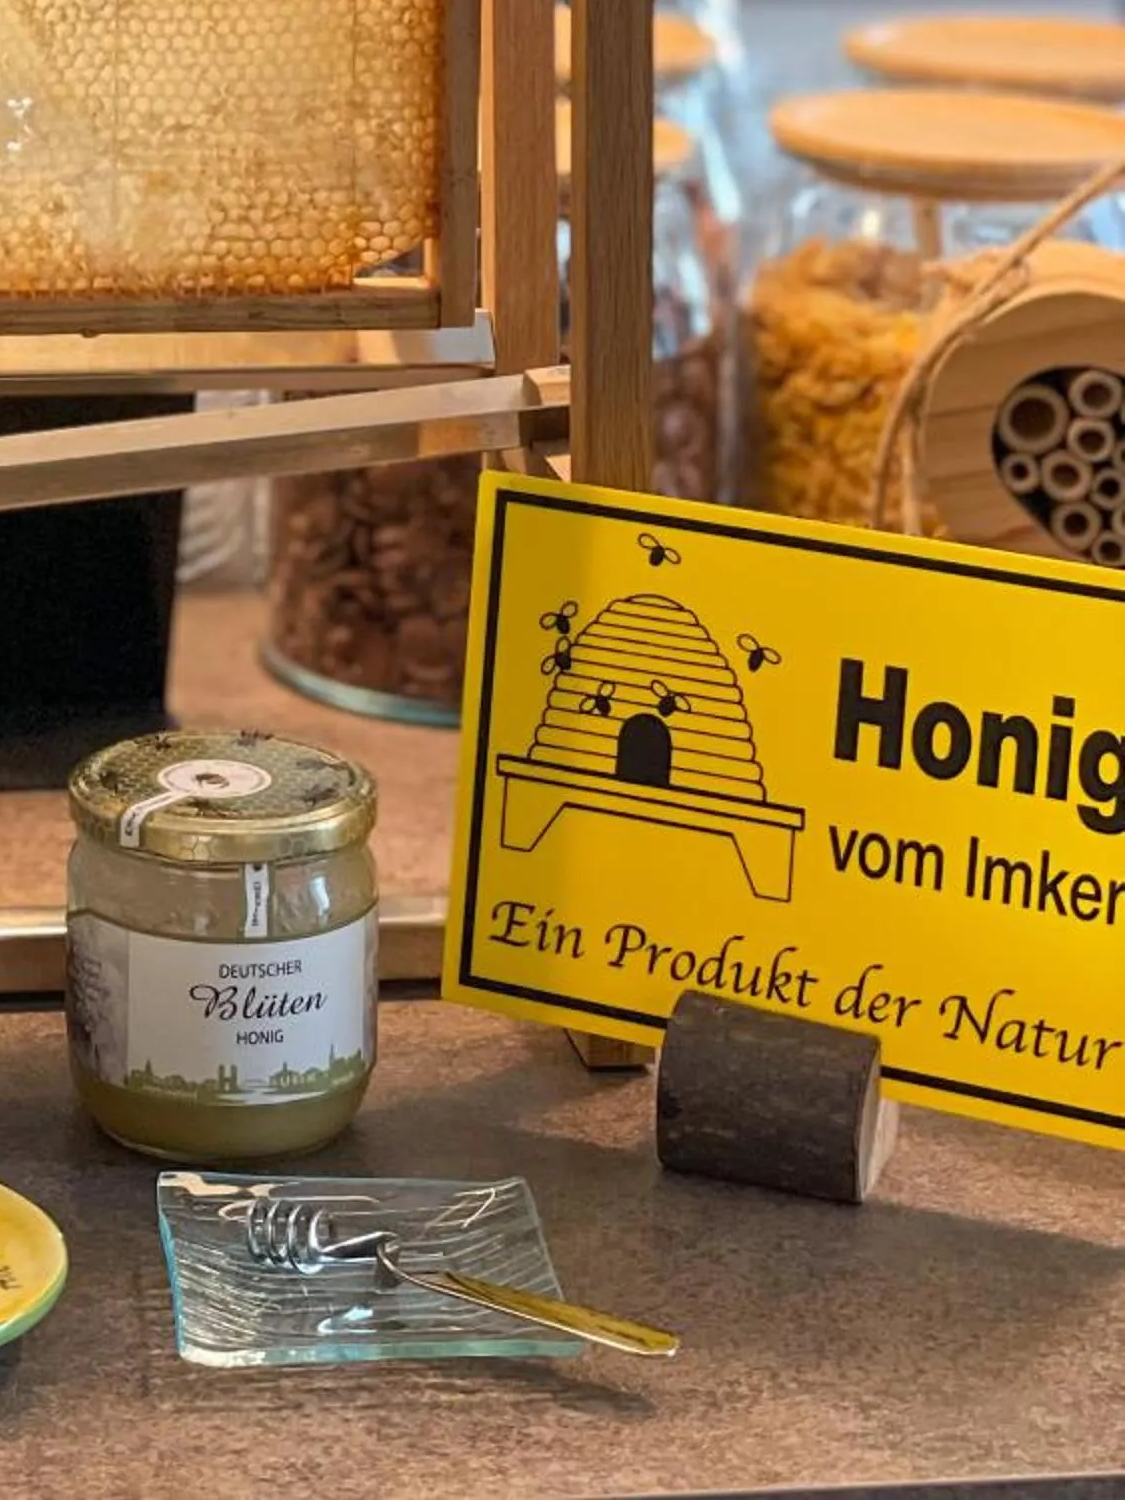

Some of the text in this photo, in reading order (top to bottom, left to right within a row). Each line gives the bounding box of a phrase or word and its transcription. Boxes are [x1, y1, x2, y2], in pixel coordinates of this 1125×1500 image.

[833, 657, 1125, 835] Honig
[828, 824, 1125, 926] vom Imker
[189, 984, 328, 1020] Blüten
[218, 959, 302, 979] DEUTSCHER
[488, 900, 1124, 1070] Ein Produkt der Natur
[236, 1030, 284, 1045] HONIG
